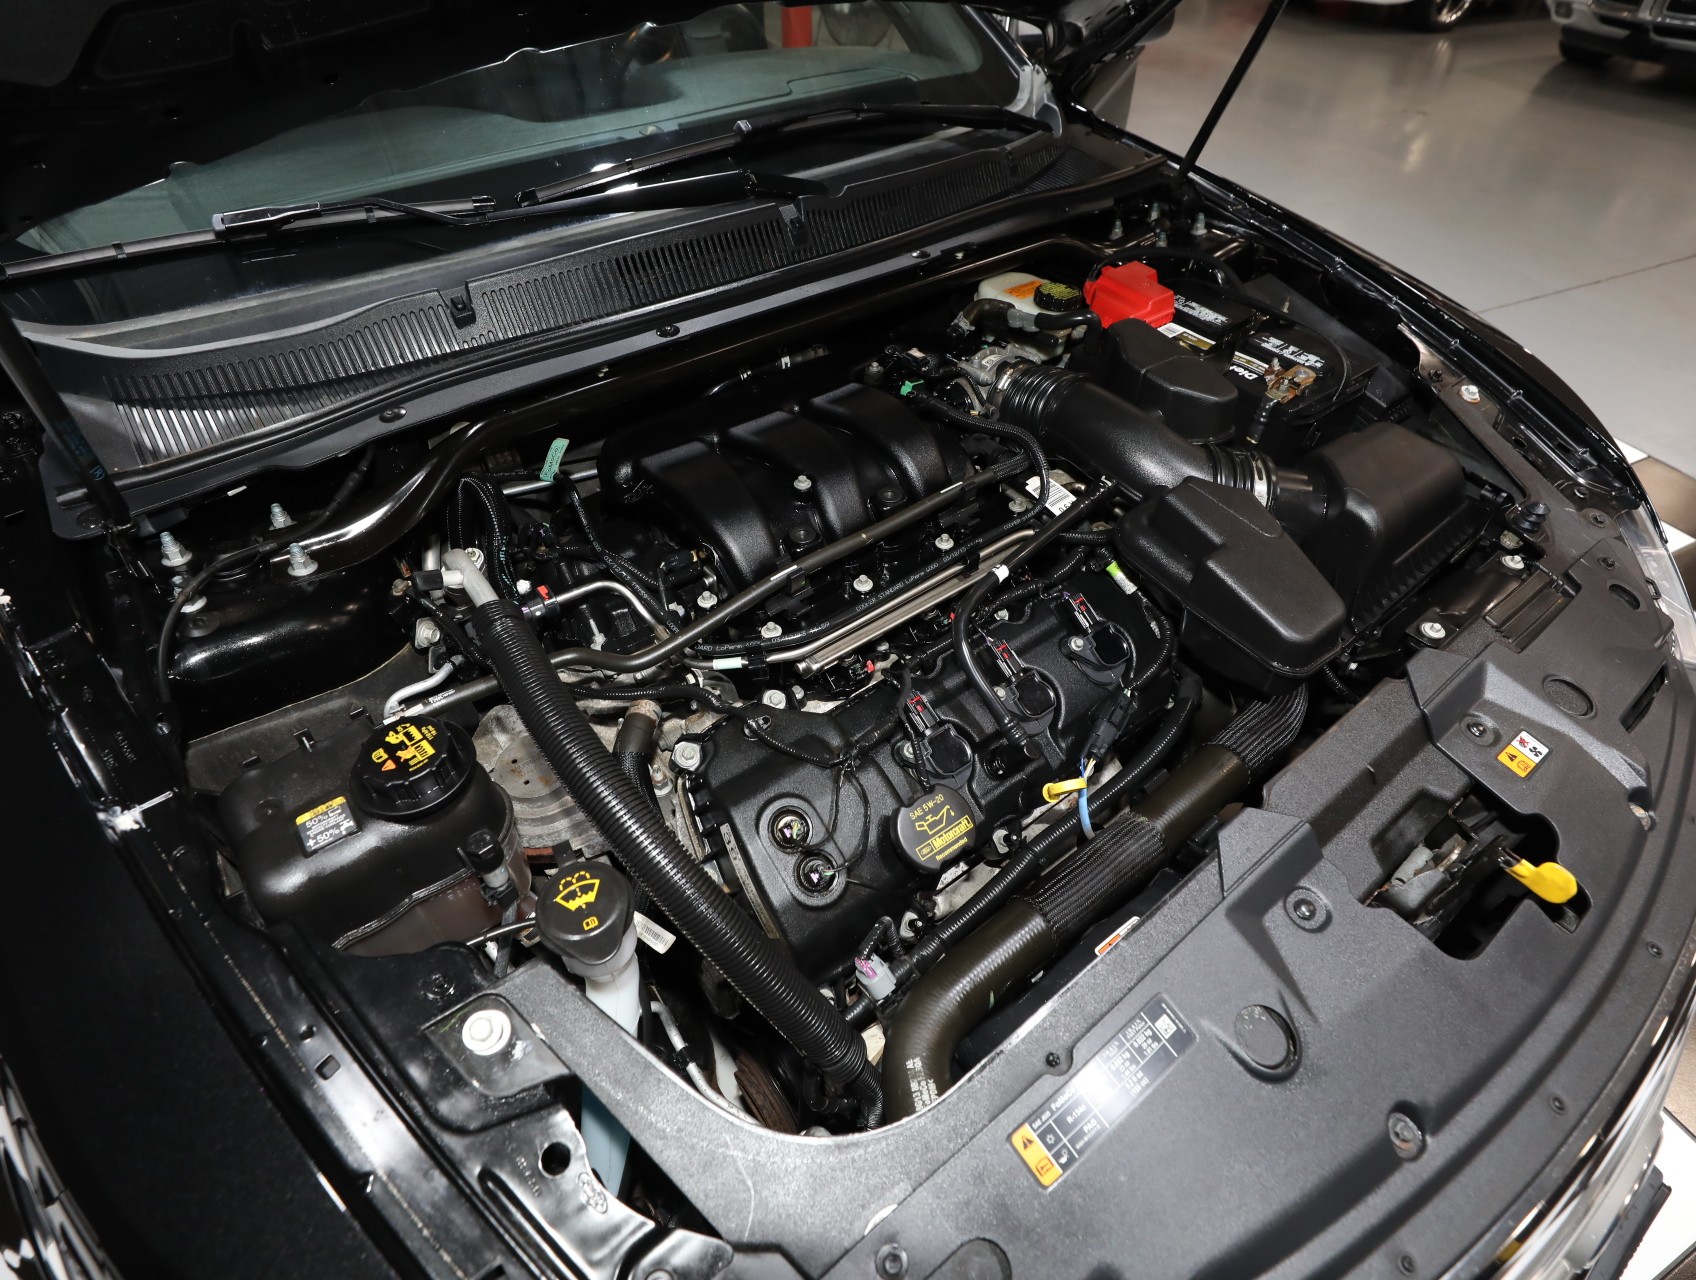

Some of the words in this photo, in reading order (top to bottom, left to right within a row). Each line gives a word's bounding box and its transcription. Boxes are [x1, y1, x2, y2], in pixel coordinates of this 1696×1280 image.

[910, 808, 924, 820] SAE
[923, 794, 944, 812] 5W-20
[305, 814, 328, 828] 50%
[316, 828, 340, 842] 50%
[932, 819, 971, 849] Motorcraft
[936, 836, 968, 861] Recommended
[1083, 1118, 1098, 1134] PAG
